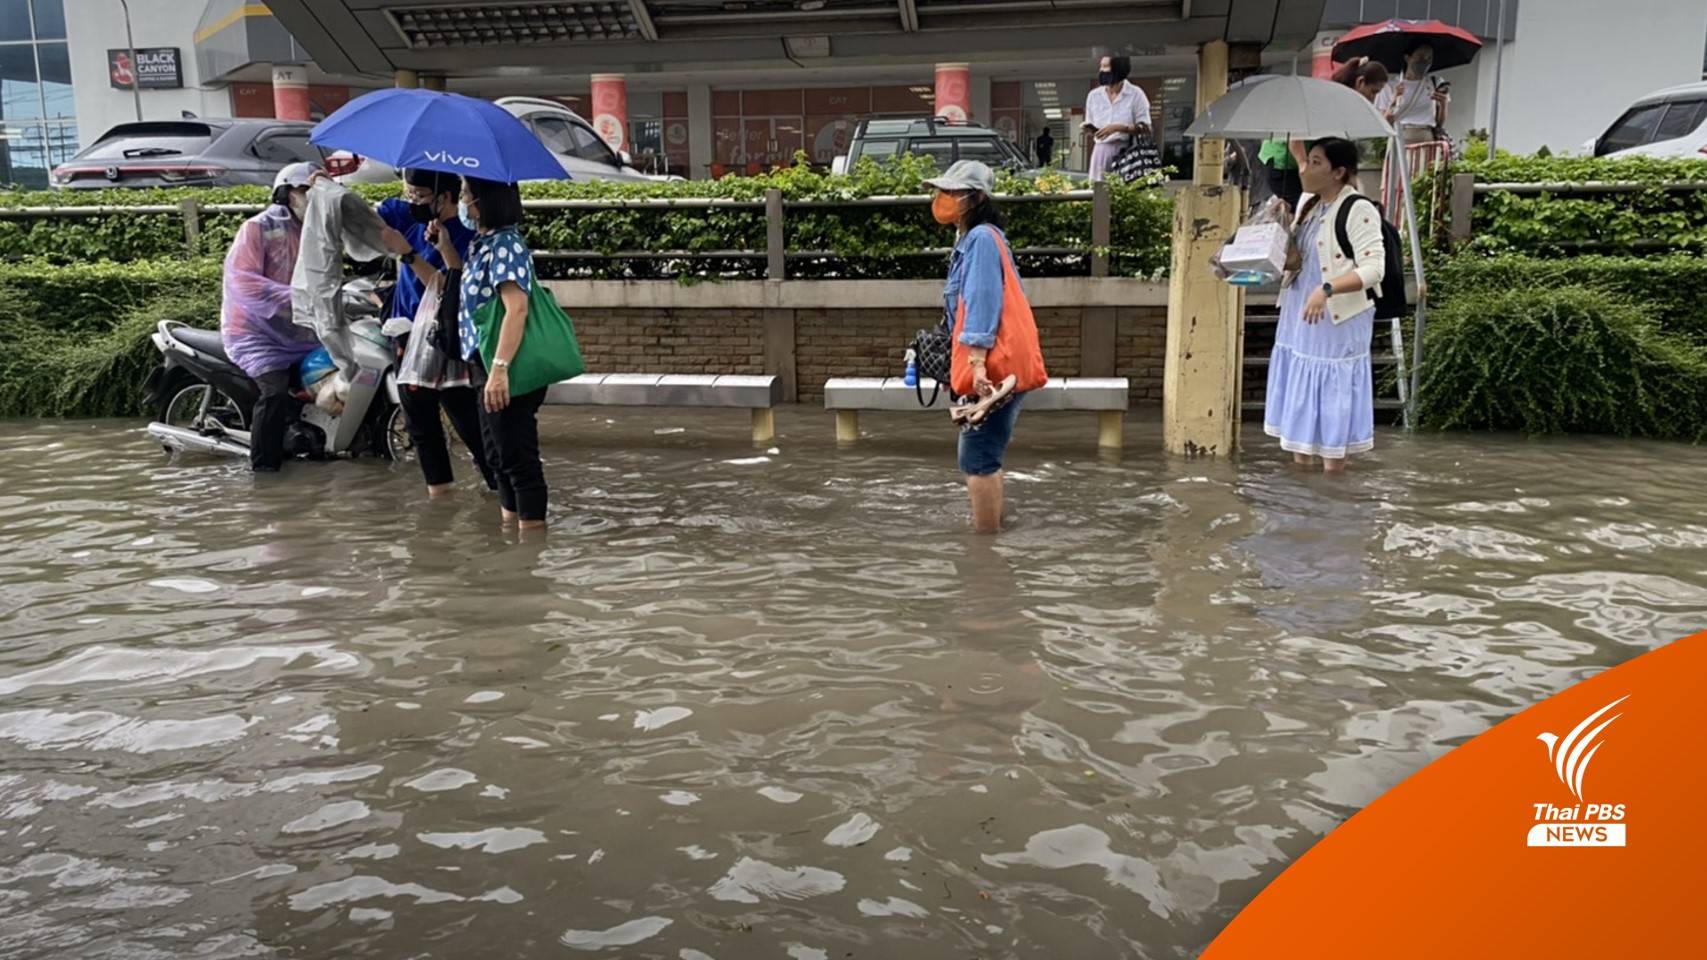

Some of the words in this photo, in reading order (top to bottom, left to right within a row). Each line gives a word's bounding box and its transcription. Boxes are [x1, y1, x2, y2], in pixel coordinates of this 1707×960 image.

[136, 53, 176, 64] BLACK
[137, 64, 176, 73] CANYON
[424, 150, 480, 168] vivo
